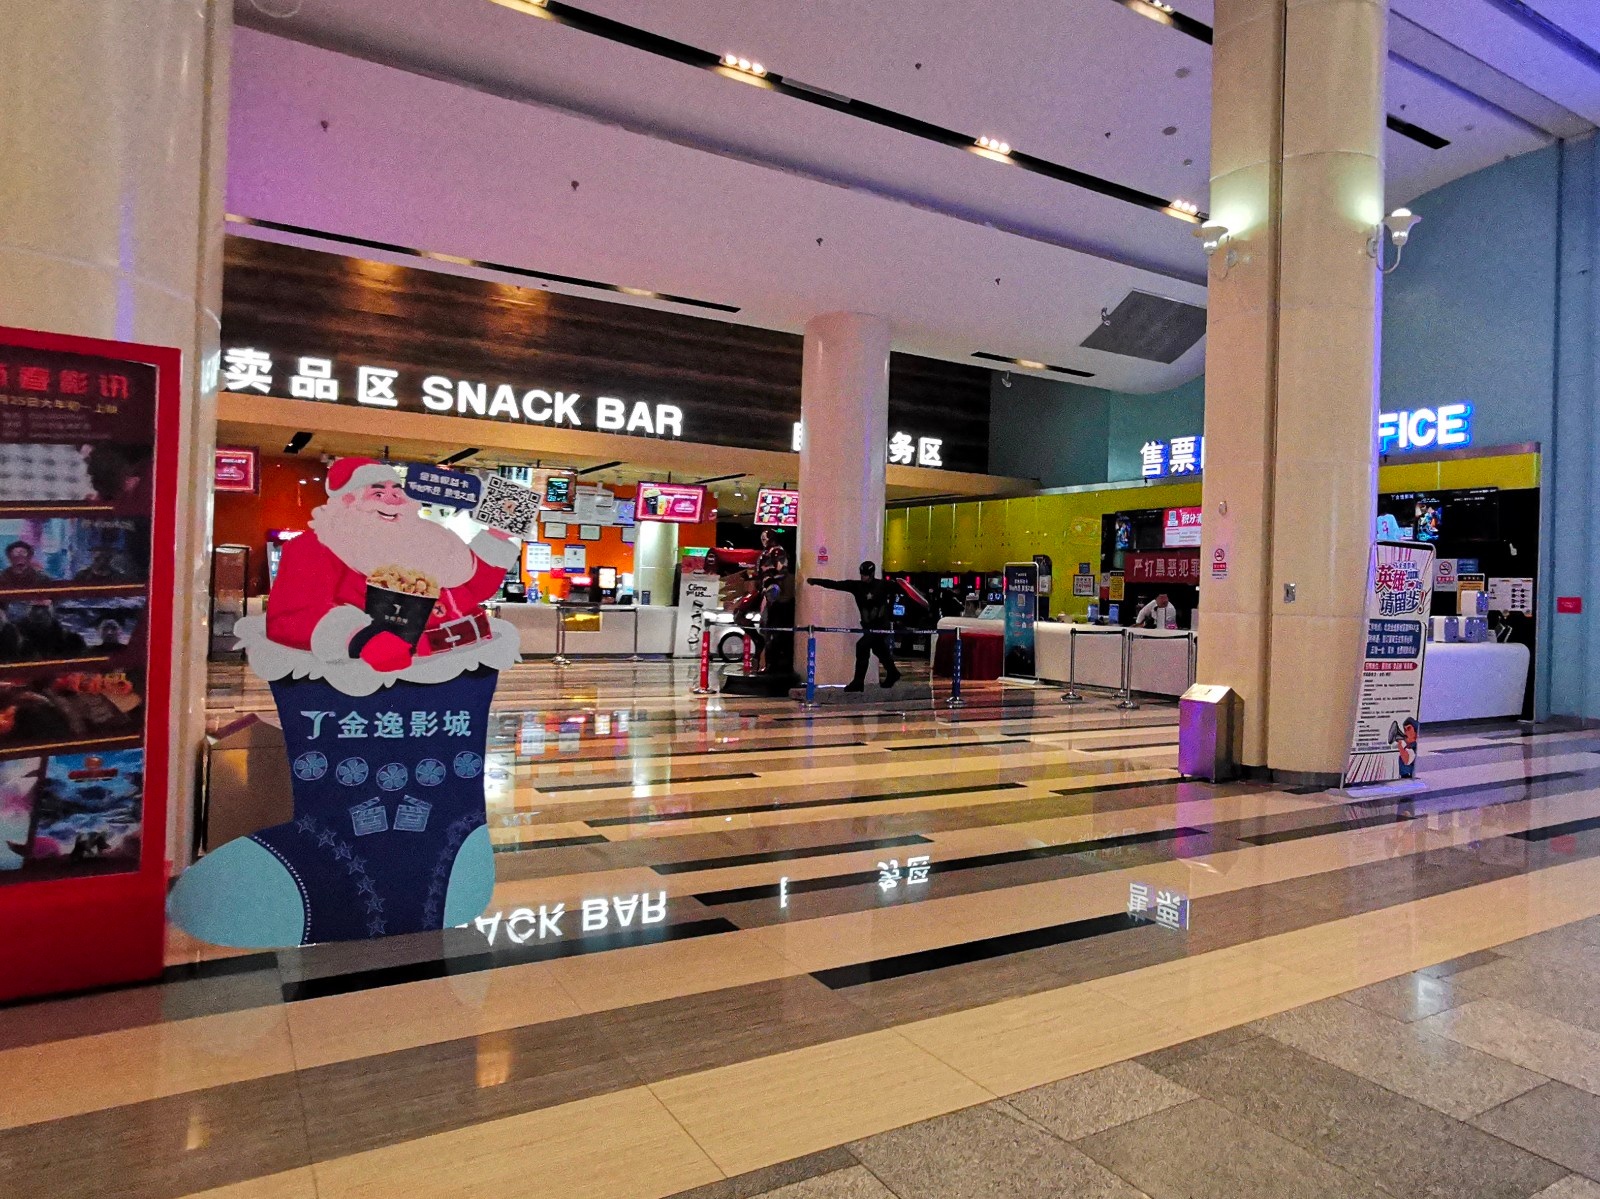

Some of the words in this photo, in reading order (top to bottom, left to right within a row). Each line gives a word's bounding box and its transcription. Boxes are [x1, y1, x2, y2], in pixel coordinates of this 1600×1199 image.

[224, 347, 398, 407] 卖品区
[422, 375, 582, 426] SNACK
[596, 396, 683, 436] BAR
[885, 431, 943, 466] 务区
[1140, 436, 1204, 476] 售票
[1376, 565, 1406, 592] 英雄
